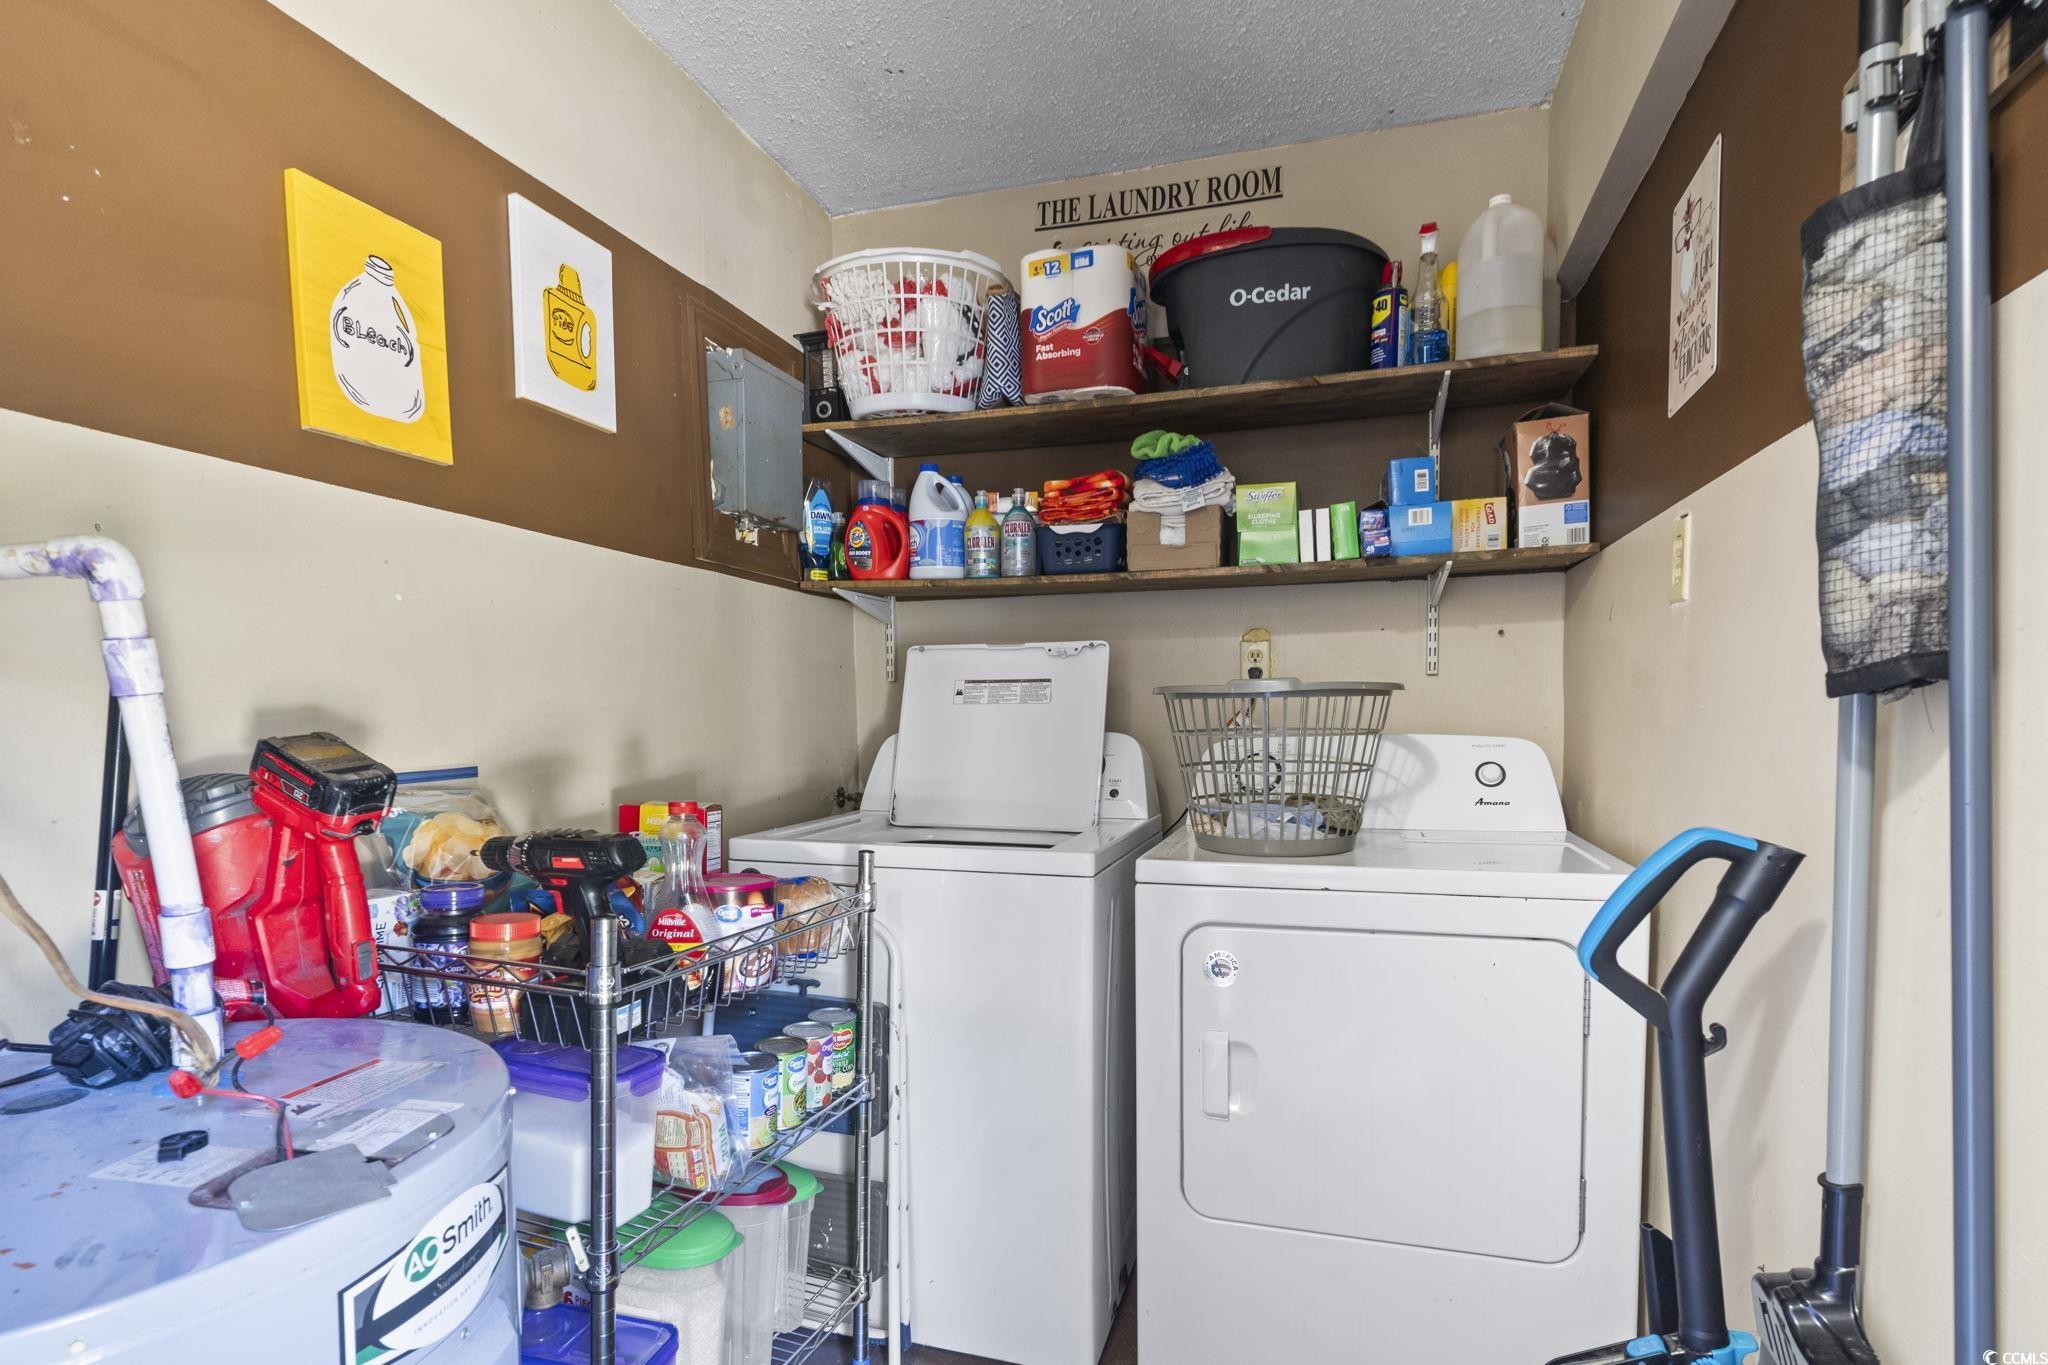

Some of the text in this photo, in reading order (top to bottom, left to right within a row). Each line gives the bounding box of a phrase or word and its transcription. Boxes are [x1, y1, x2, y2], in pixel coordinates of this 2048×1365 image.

[1037, 165, 1283, 227] THE LAUNDRY ROOM
[1699, 237, 1714, 283] GIRL
[1043, 260, 1061, 276] 12
[1229, 283, 1311, 308] O-Cedar
[1035, 298, 1073, 332] Scott
[1035, 343, 1054, 353] Fast
[1035, 347, 1082, 361] Absorbing
[1676, 323, 1712, 385] CHICKENS
[1247, 489, 1283, 503] Swiffer
[810, 511, 832, 520] DAWN
[1484, 503, 1496, 525] GLAD
[1003, 521, 1032, 535] CLORALEN
[1474, 797, 1511, 807] Amana
[657, 917, 688, 927] Millville
[651, 928, 695, 940] Original
[442, 1196, 492, 1254] Smith
[563, 1290, 574, 1305] 6
